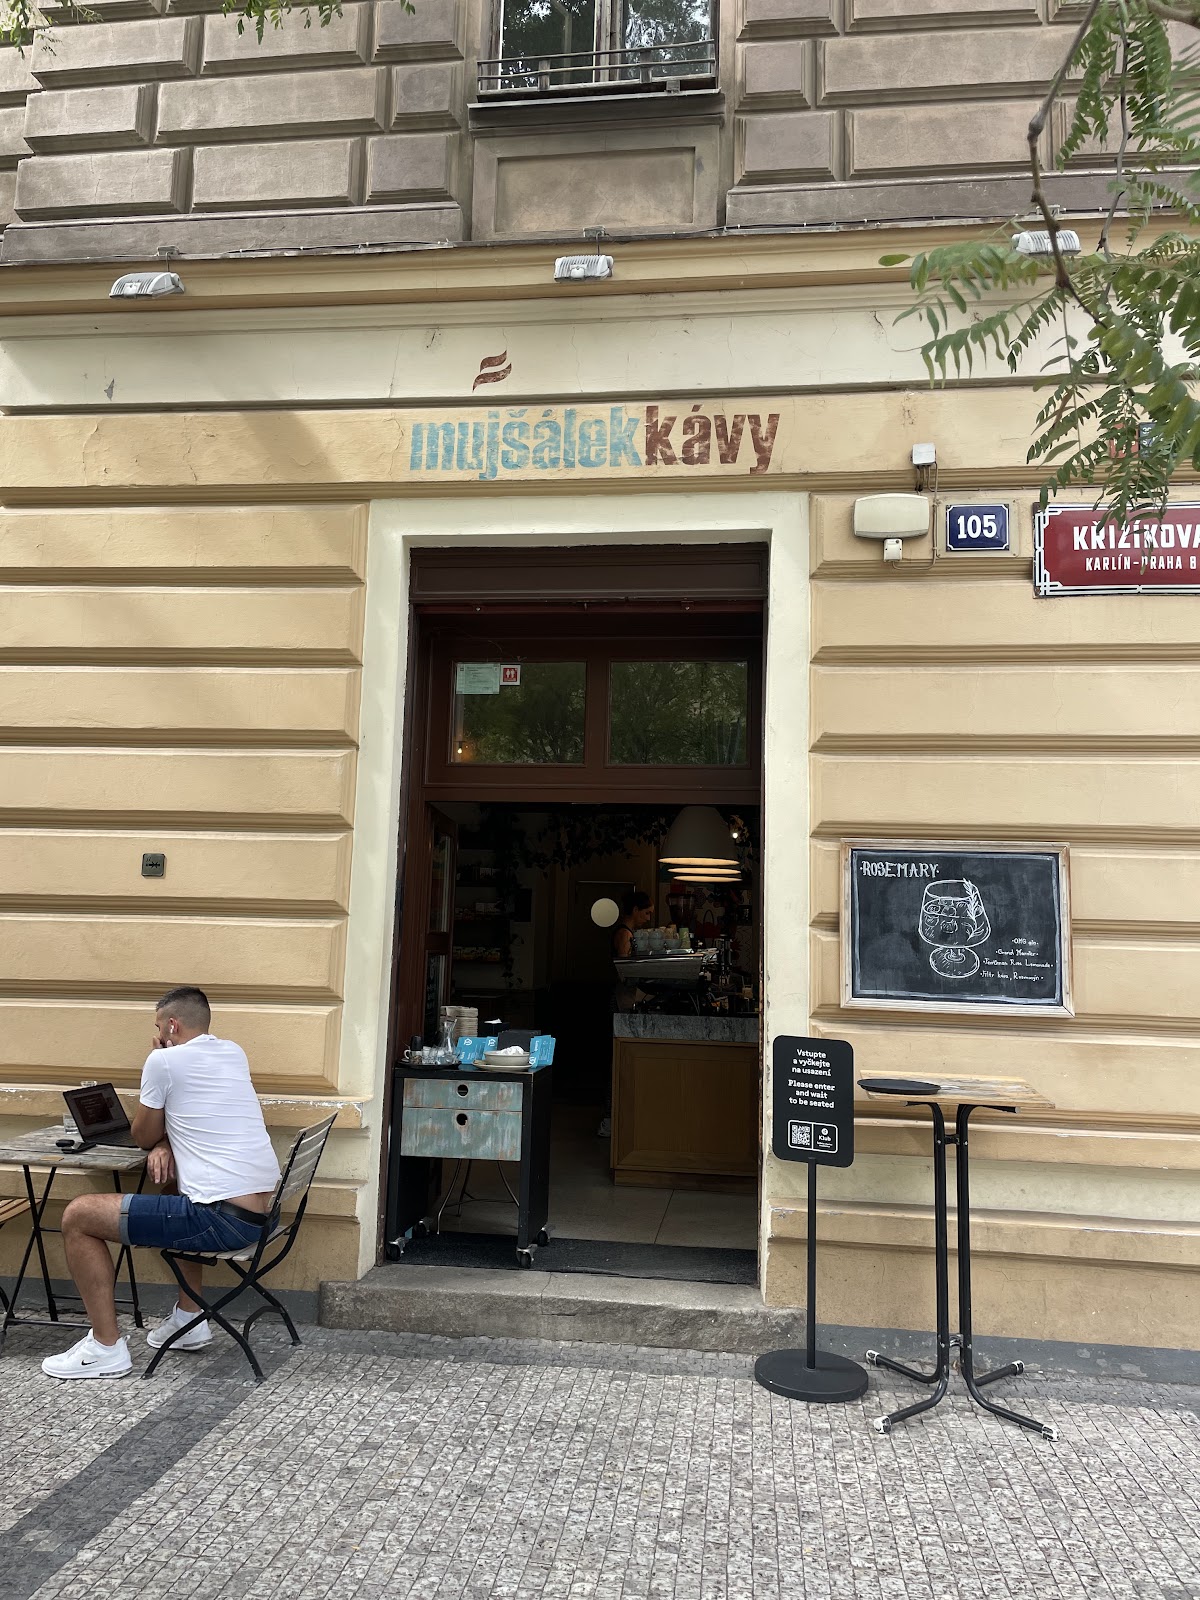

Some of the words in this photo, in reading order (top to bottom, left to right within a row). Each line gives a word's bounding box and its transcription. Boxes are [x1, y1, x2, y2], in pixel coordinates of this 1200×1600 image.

[957, 514, 998, 539] 105
[1189, 555, 1197, 569] 8
[862, 860, 938, 878] ROSEMARY
[796, 1048, 827, 1059] Vstupte
[798, 1058, 831, 1068] vyčkejte
[802, 1068, 832, 1076] usazení
[788, 1079, 813, 1088] Please
[814, 1083, 835, 1091] enter
[795, 1089, 810, 1097] and
[810, 1091, 828, 1099] wait
[798, 1097, 808, 1105] be
[809, 1099, 834, 1108] seated
